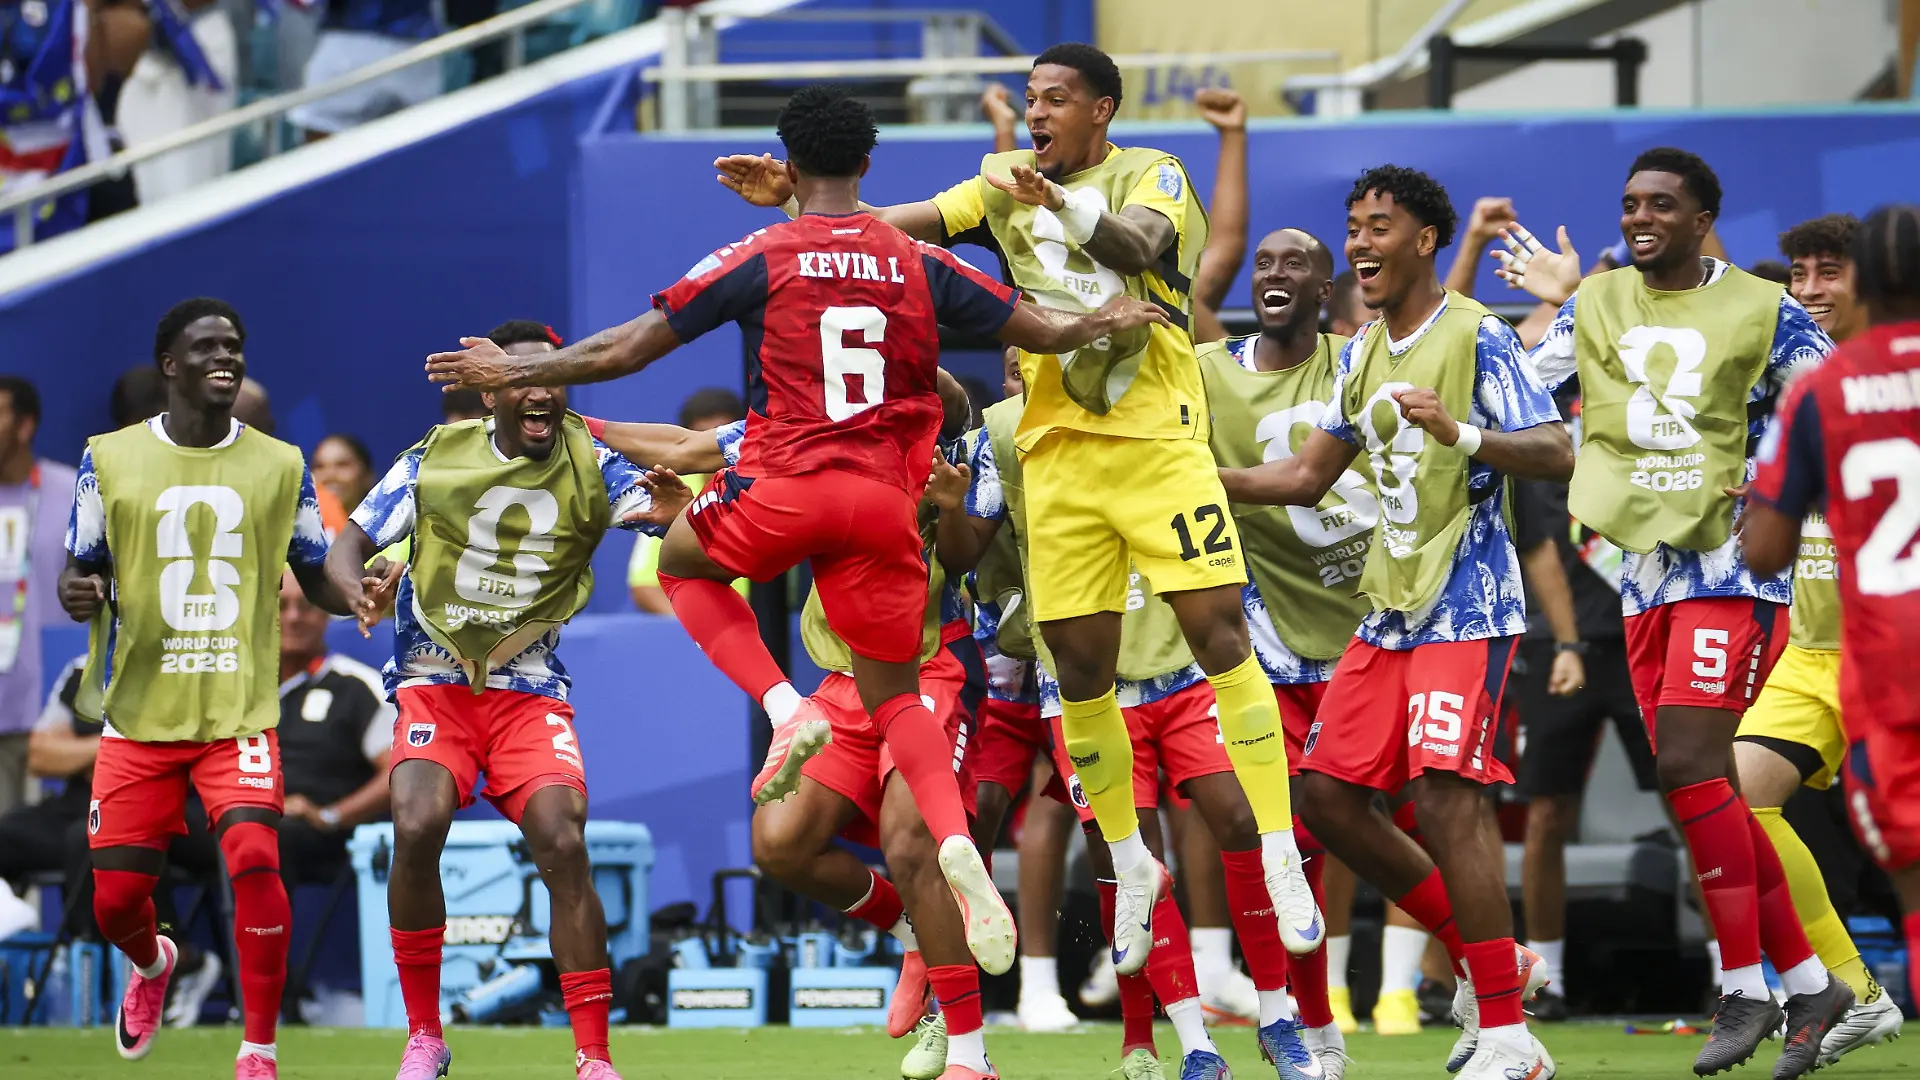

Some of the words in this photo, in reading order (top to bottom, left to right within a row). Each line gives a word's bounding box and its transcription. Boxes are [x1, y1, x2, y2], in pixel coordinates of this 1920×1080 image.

[1061, 275, 1102, 296] FIFA
[820, 305, 888, 423] 6
[1650, 422, 1686, 438] FIFA
[1635, 456, 1683, 469] WORLD
[1683, 453, 1706, 467] CUP
[1629, 469, 1704, 492] 2026
[1170, 503, 1233, 561] 12
[1310, 540, 1367, 566] WORLD
[1800, 543, 1827, 557] ORLD
[1318, 554, 1368, 588] 20
[477, 576, 517, 598] FIFA
[183, 602, 217, 618] FIFA
[162, 637, 210, 650] WORLD
[210, 637, 239, 650] CUP
[1692, 628, 1729, 678] 5
[160, 652, 239, 674] 2026
[1690, 680, 1726, 695] capelli
[1408, 691, 1464, 748] 25
[545, 712, 579, 758] 2
[236, 731, 272, 774] 8
[1421, 742, 1459, 755] capelli
